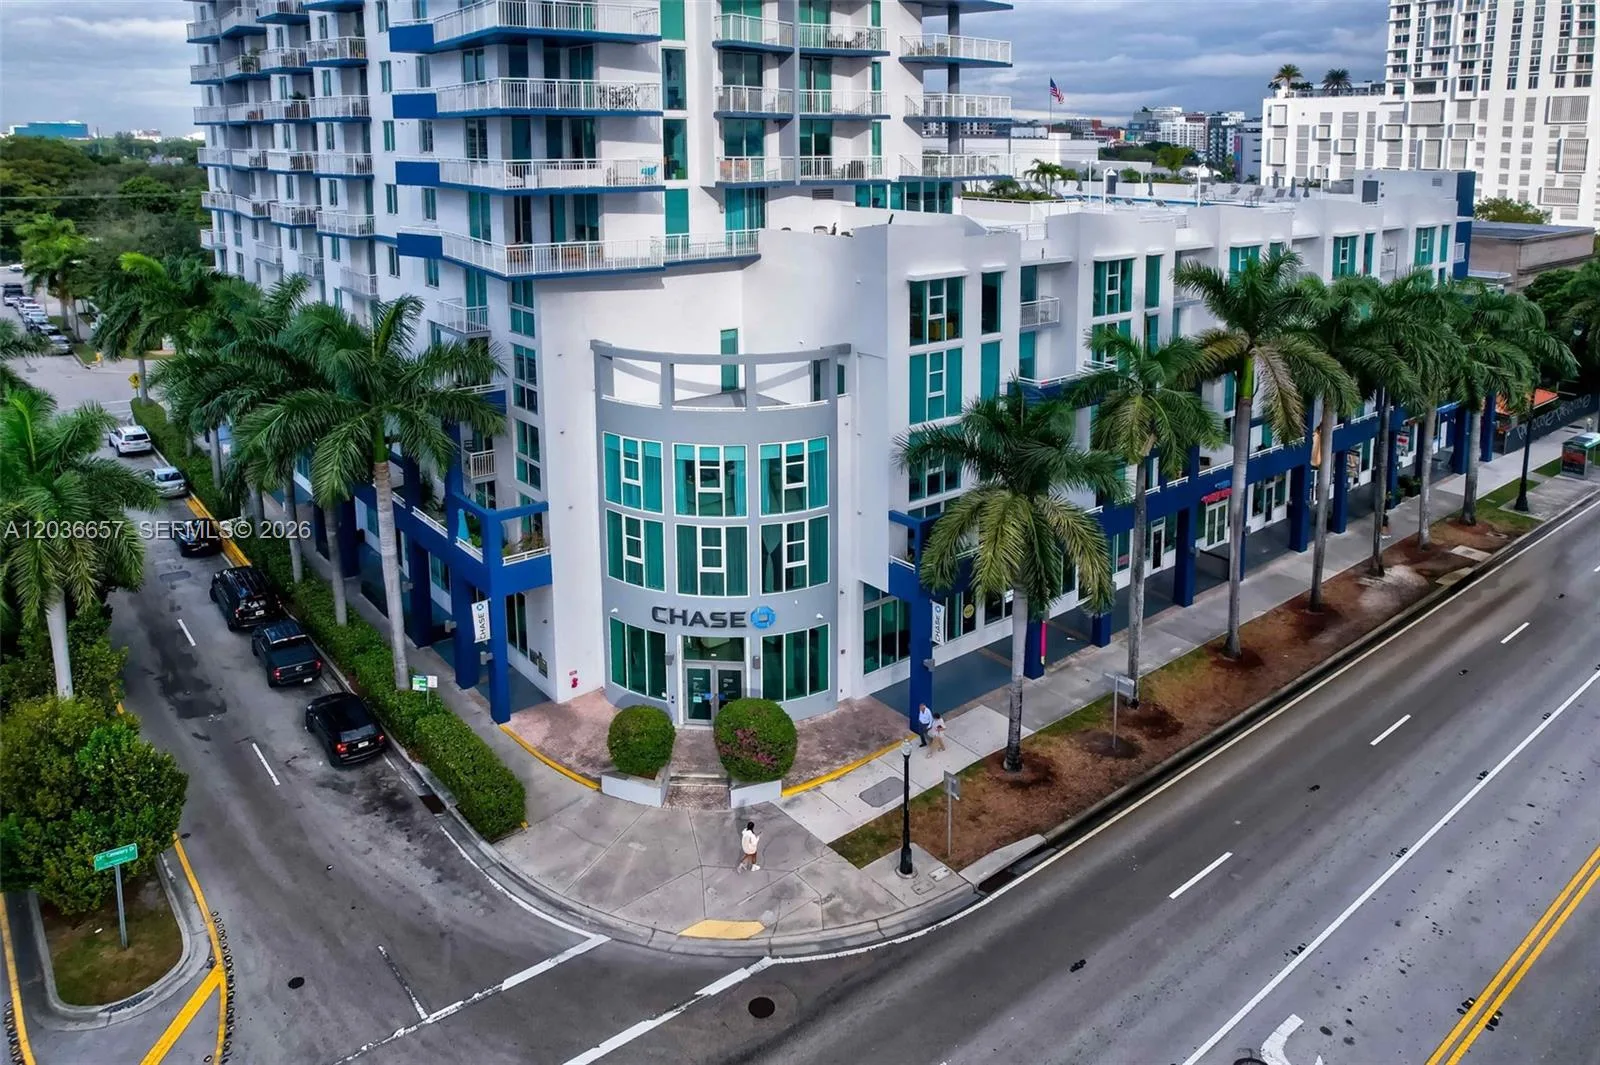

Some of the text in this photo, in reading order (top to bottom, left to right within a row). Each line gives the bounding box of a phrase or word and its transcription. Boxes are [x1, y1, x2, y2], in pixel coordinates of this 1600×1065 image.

[478, 612, 487, 640] CHASE
[651, 606, 747, 628] CHASE
[934, 615, 942, 642] CHASE
